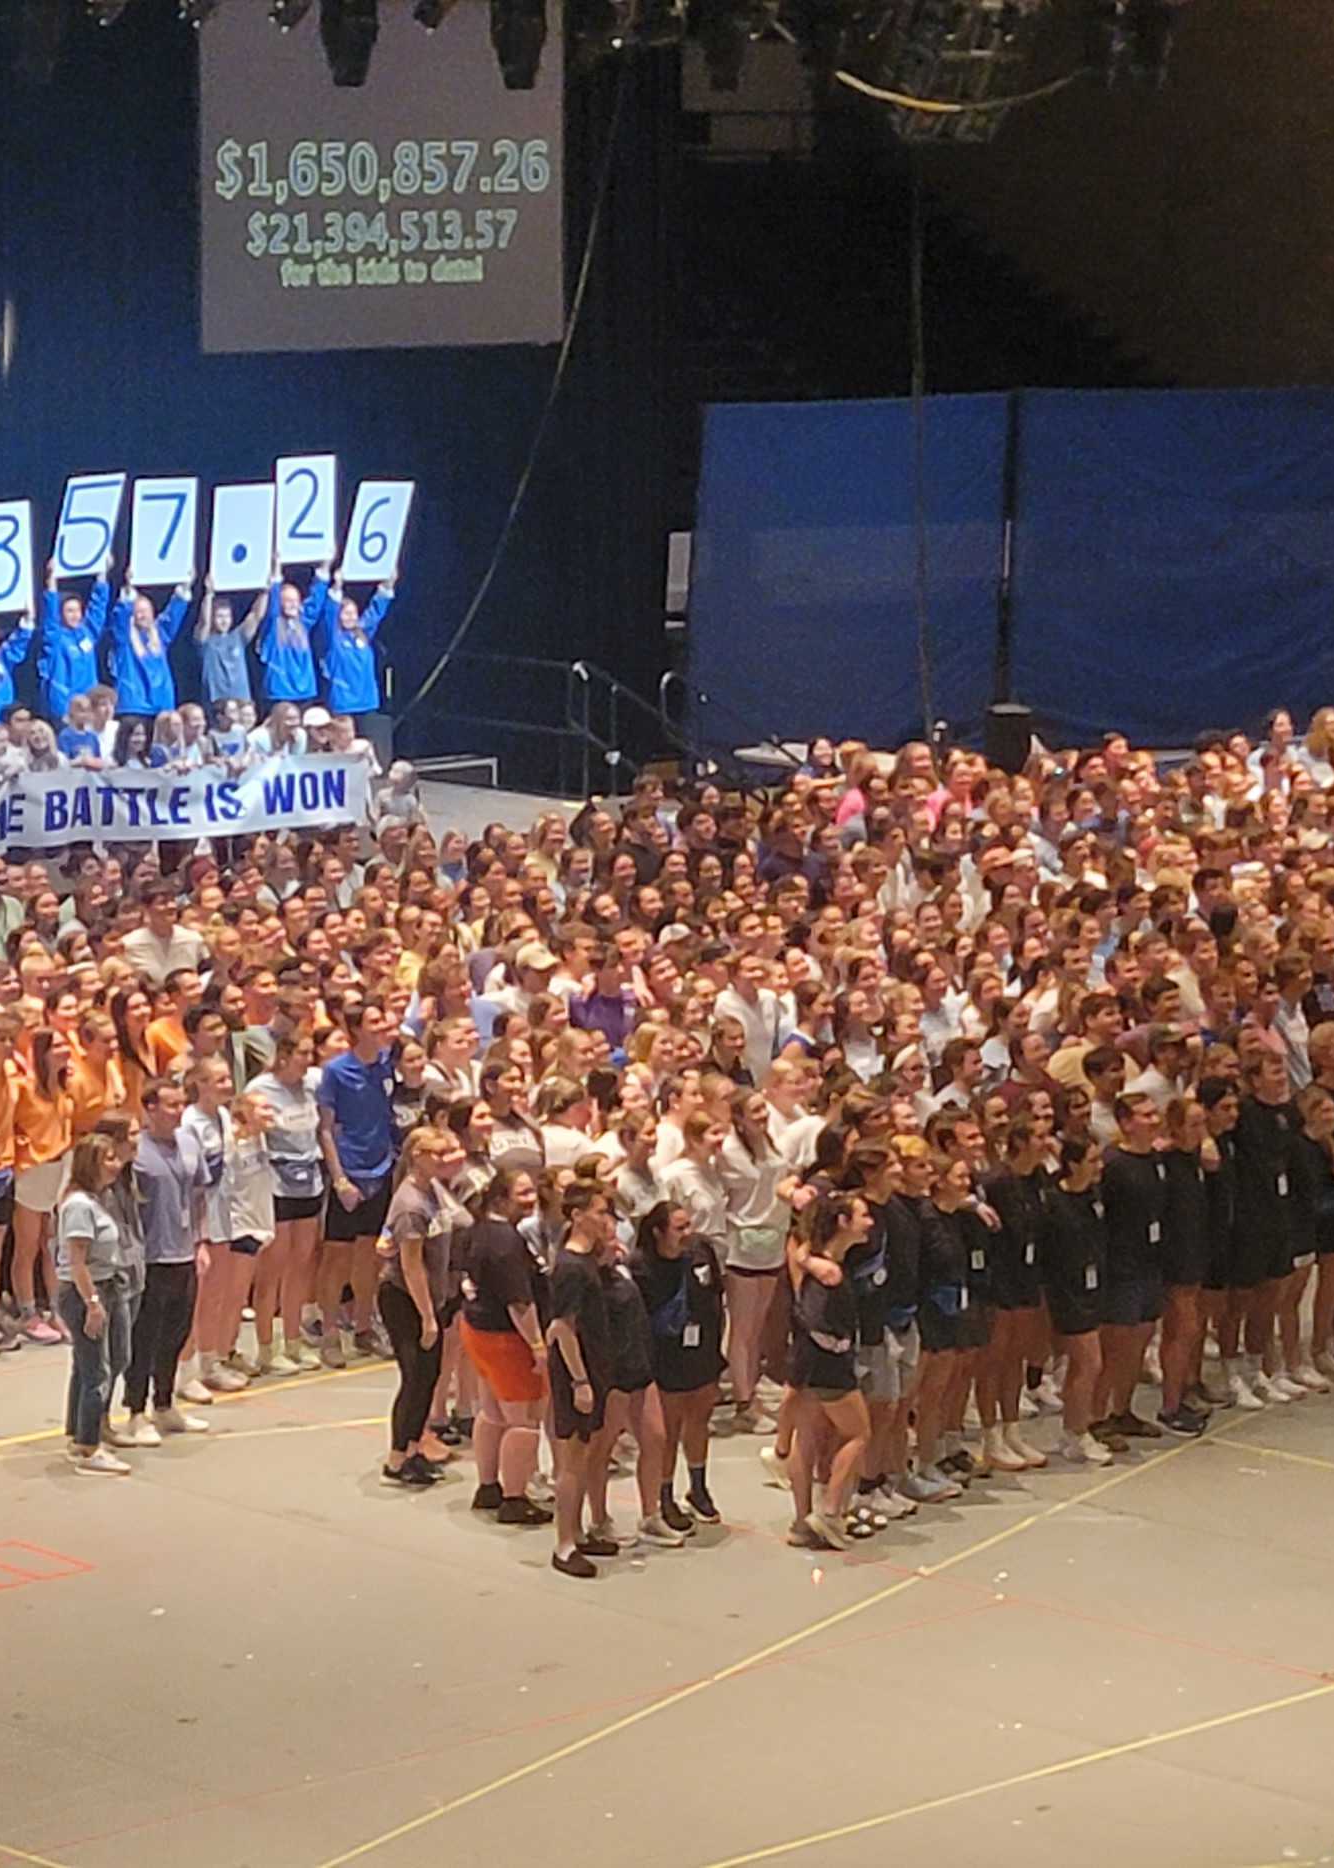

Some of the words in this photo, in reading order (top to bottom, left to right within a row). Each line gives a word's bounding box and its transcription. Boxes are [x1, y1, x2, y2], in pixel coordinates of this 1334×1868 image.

[215, 139, 551, 205] $1,650,857.26
[246, 208, 518, 258] $21,394,513.57
[280, 258, 314, 288] for
[403, 258, 428, 283] to
[44, 784, 194, 832] BATTLE
[205, 780, 245, 822] IS
[262, 767, 348, 816] WON
